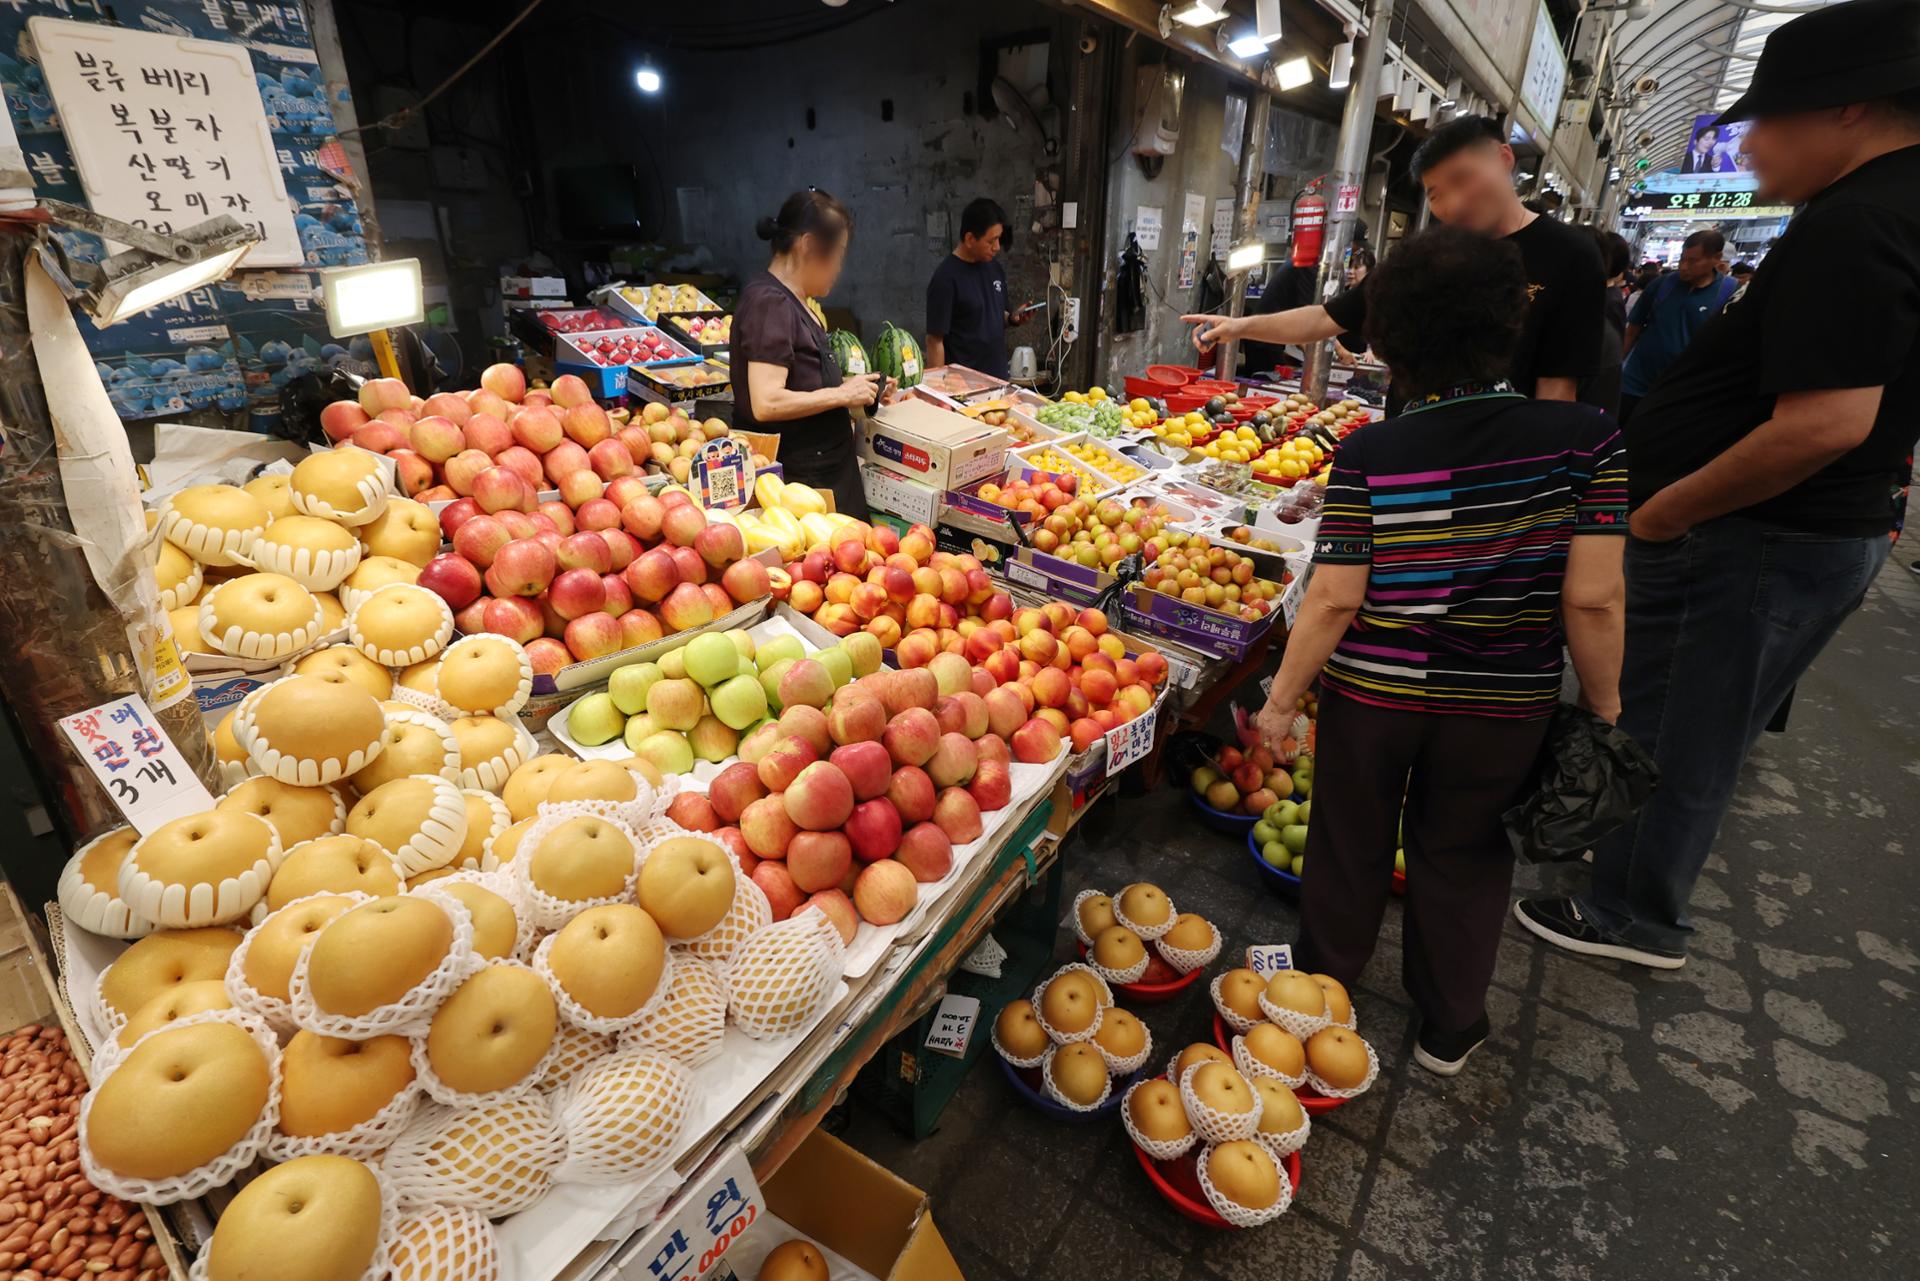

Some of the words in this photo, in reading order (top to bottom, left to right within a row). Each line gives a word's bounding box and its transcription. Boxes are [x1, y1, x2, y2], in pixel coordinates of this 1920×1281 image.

[1667, 194, 1701, 209] 오후
[1709, 192, 1753, 208] 12:28
[72, 708, 107, 744] 햇
[110, 702, 143, 727] 배
